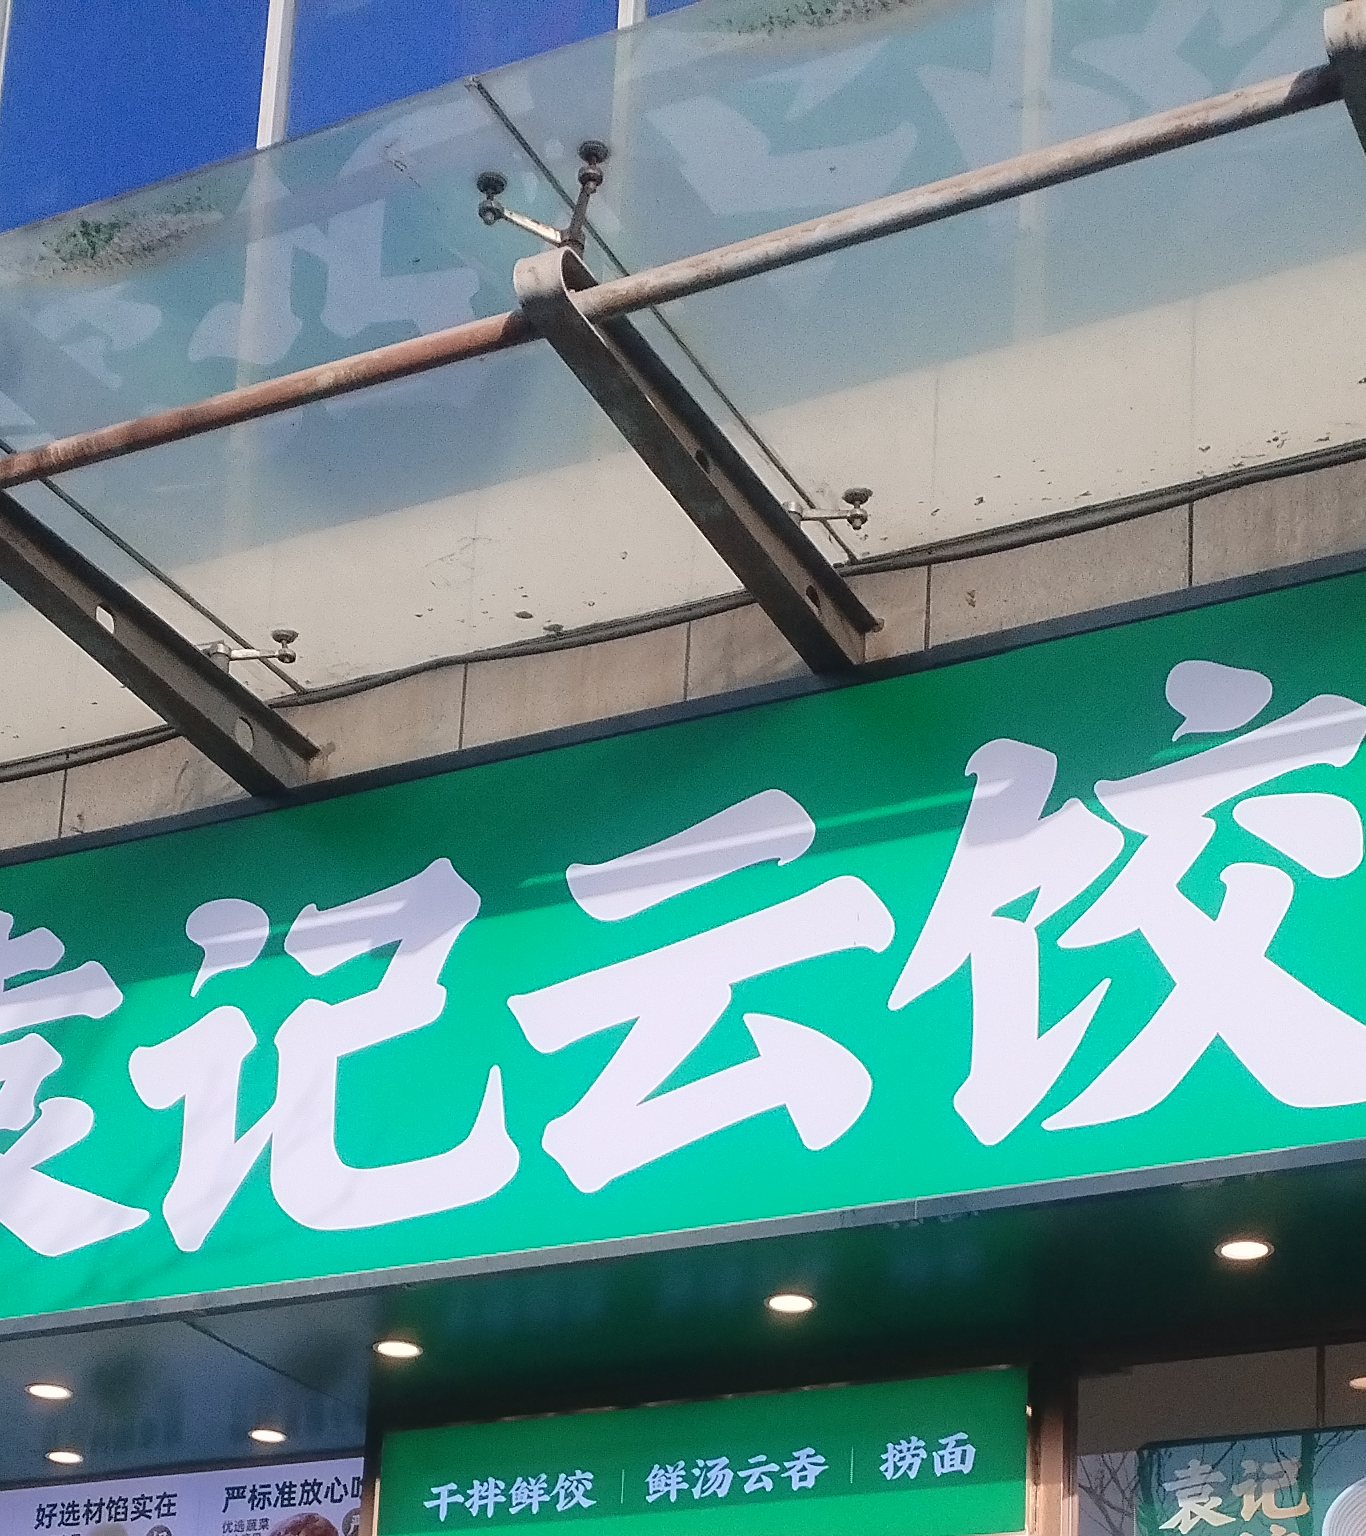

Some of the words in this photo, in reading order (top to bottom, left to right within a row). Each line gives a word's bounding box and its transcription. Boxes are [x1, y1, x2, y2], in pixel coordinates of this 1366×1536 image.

[422, 1468, 597, 1523] 干拌鲜饺
[643, 1446, 829, 1504] 鲜汤云吞
[879, 1431, 977, 1482] 捞面
[1162, 1457, 1312, 1534] 袁记
[33, 1490, 179, 1530] 好选材馅实在
[220, 1518, 271, 1535] 优选蔬菜
